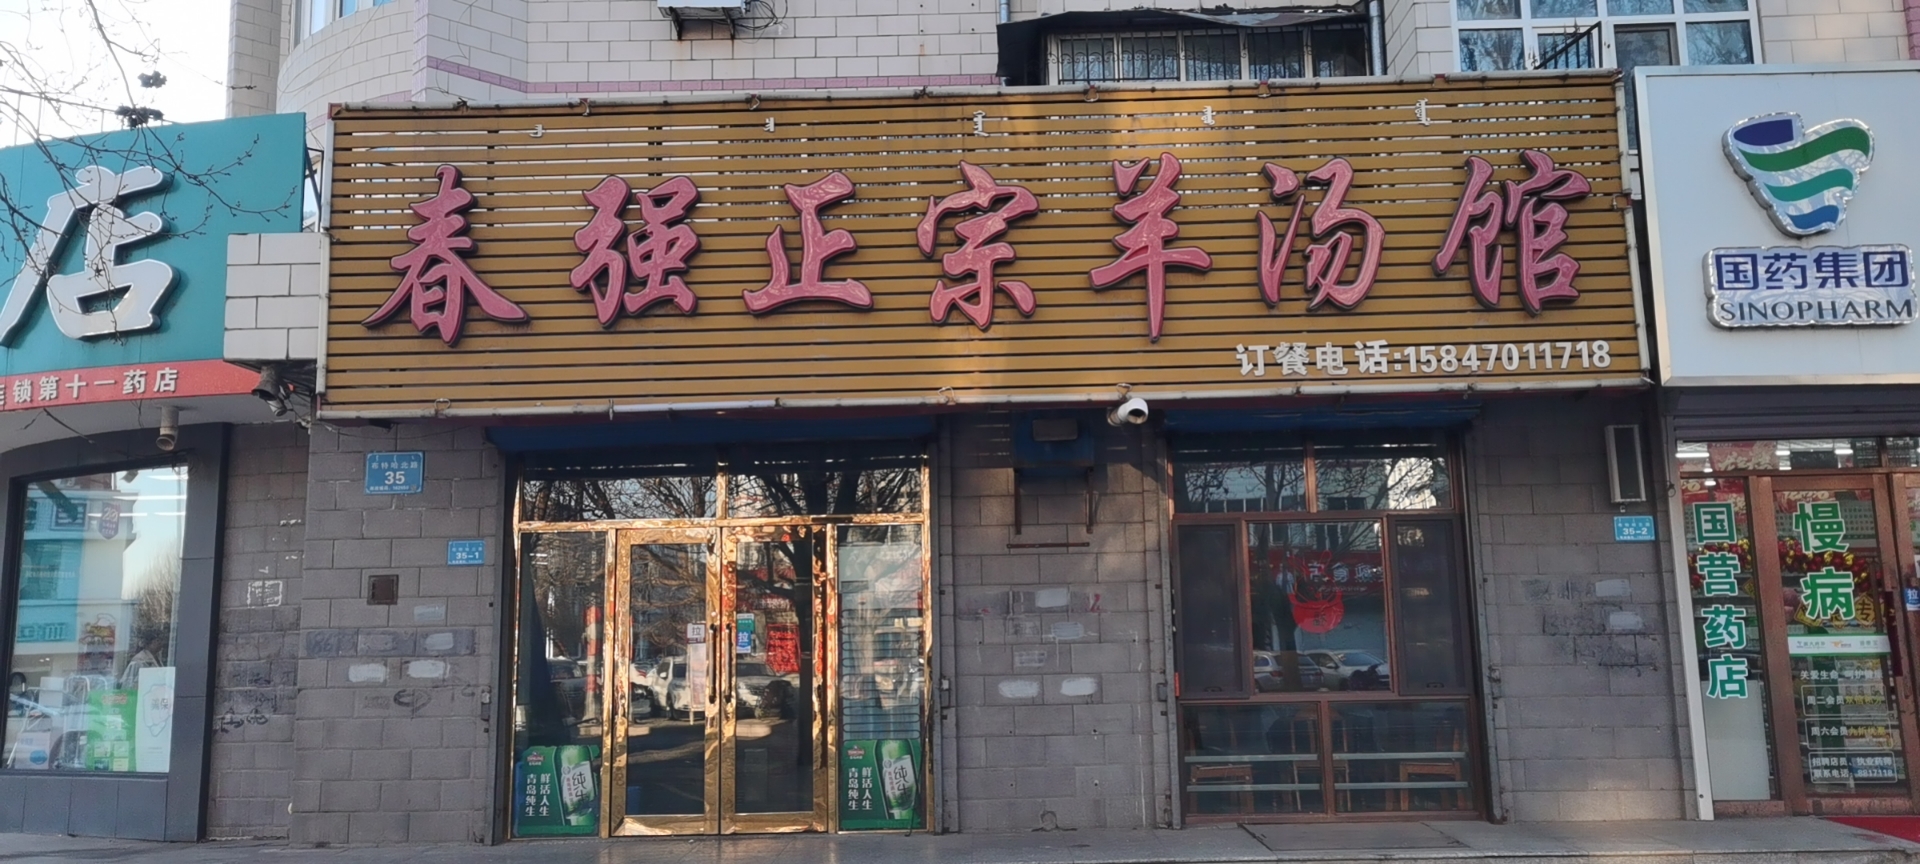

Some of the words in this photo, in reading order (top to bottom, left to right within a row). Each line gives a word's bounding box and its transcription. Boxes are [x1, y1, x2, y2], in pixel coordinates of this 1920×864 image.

[0, 165, 175, 347] 店
[361, 150, 1593, 348] 春强正宗羊汤馆
[1714, 251, 1910, 291] 国药集团
[1719, 299, 1913, 321] SINOPHARM
[384, 471, 406, 485] 35
[1622, 527, 1648, 535] 35-2
[455, 551, 479, 560] 35-1
[1793, 501, 1856, 620] 慢病
[1693, 502, 1749, 699] 国营药店
[1907, 587, 1919, 600] 拉
[692, 626, 702, 636] 拉
[738, 631, 749, 642] 拉
[1800, 670, 1839, 680] 关爱生命
[525, 773, 537, 817] 青岛纯生
[539, 773, 551, 816] 鲜活人生
[848, 767, 859, 811] 青岛纯生
[862, 766, 873, 810] 鲜活人生
